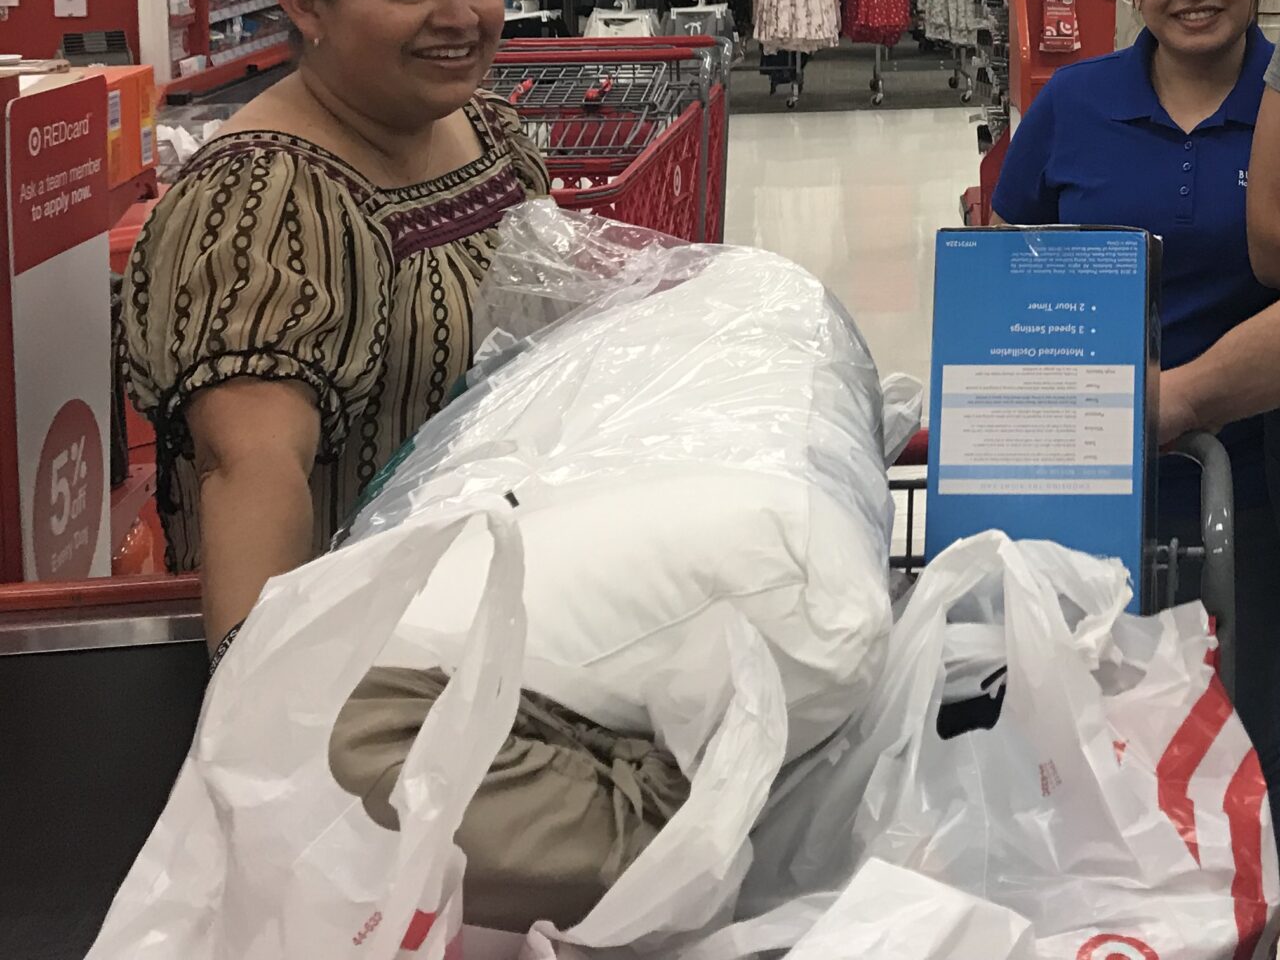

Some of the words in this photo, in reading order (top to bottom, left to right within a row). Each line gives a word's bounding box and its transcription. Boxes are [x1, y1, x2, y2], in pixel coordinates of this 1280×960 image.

[43, 113, 91, 148] REDcard
[20, 180, 37, 203] Ask
[38, 181, 45, 195] a
[46, 171, 68, 191] team
[70, 157, 102, 182] member
[32, 204, 42, 221] to
[44, 192, 70, 218] apply
[1028, 303, 1053, 311] Timer
[1055, 303, 1077, 311] Hour
[1079, 303, 1085, 311] 2
[1010, 324, 1046, 334] Settings
[1048, 323, 1076, 334] Speed
[1079, 325, 1084, 334] 3
[990, 348, 1036, 357] Oscillation
[1038, 348, 1084, 357] Motorized
